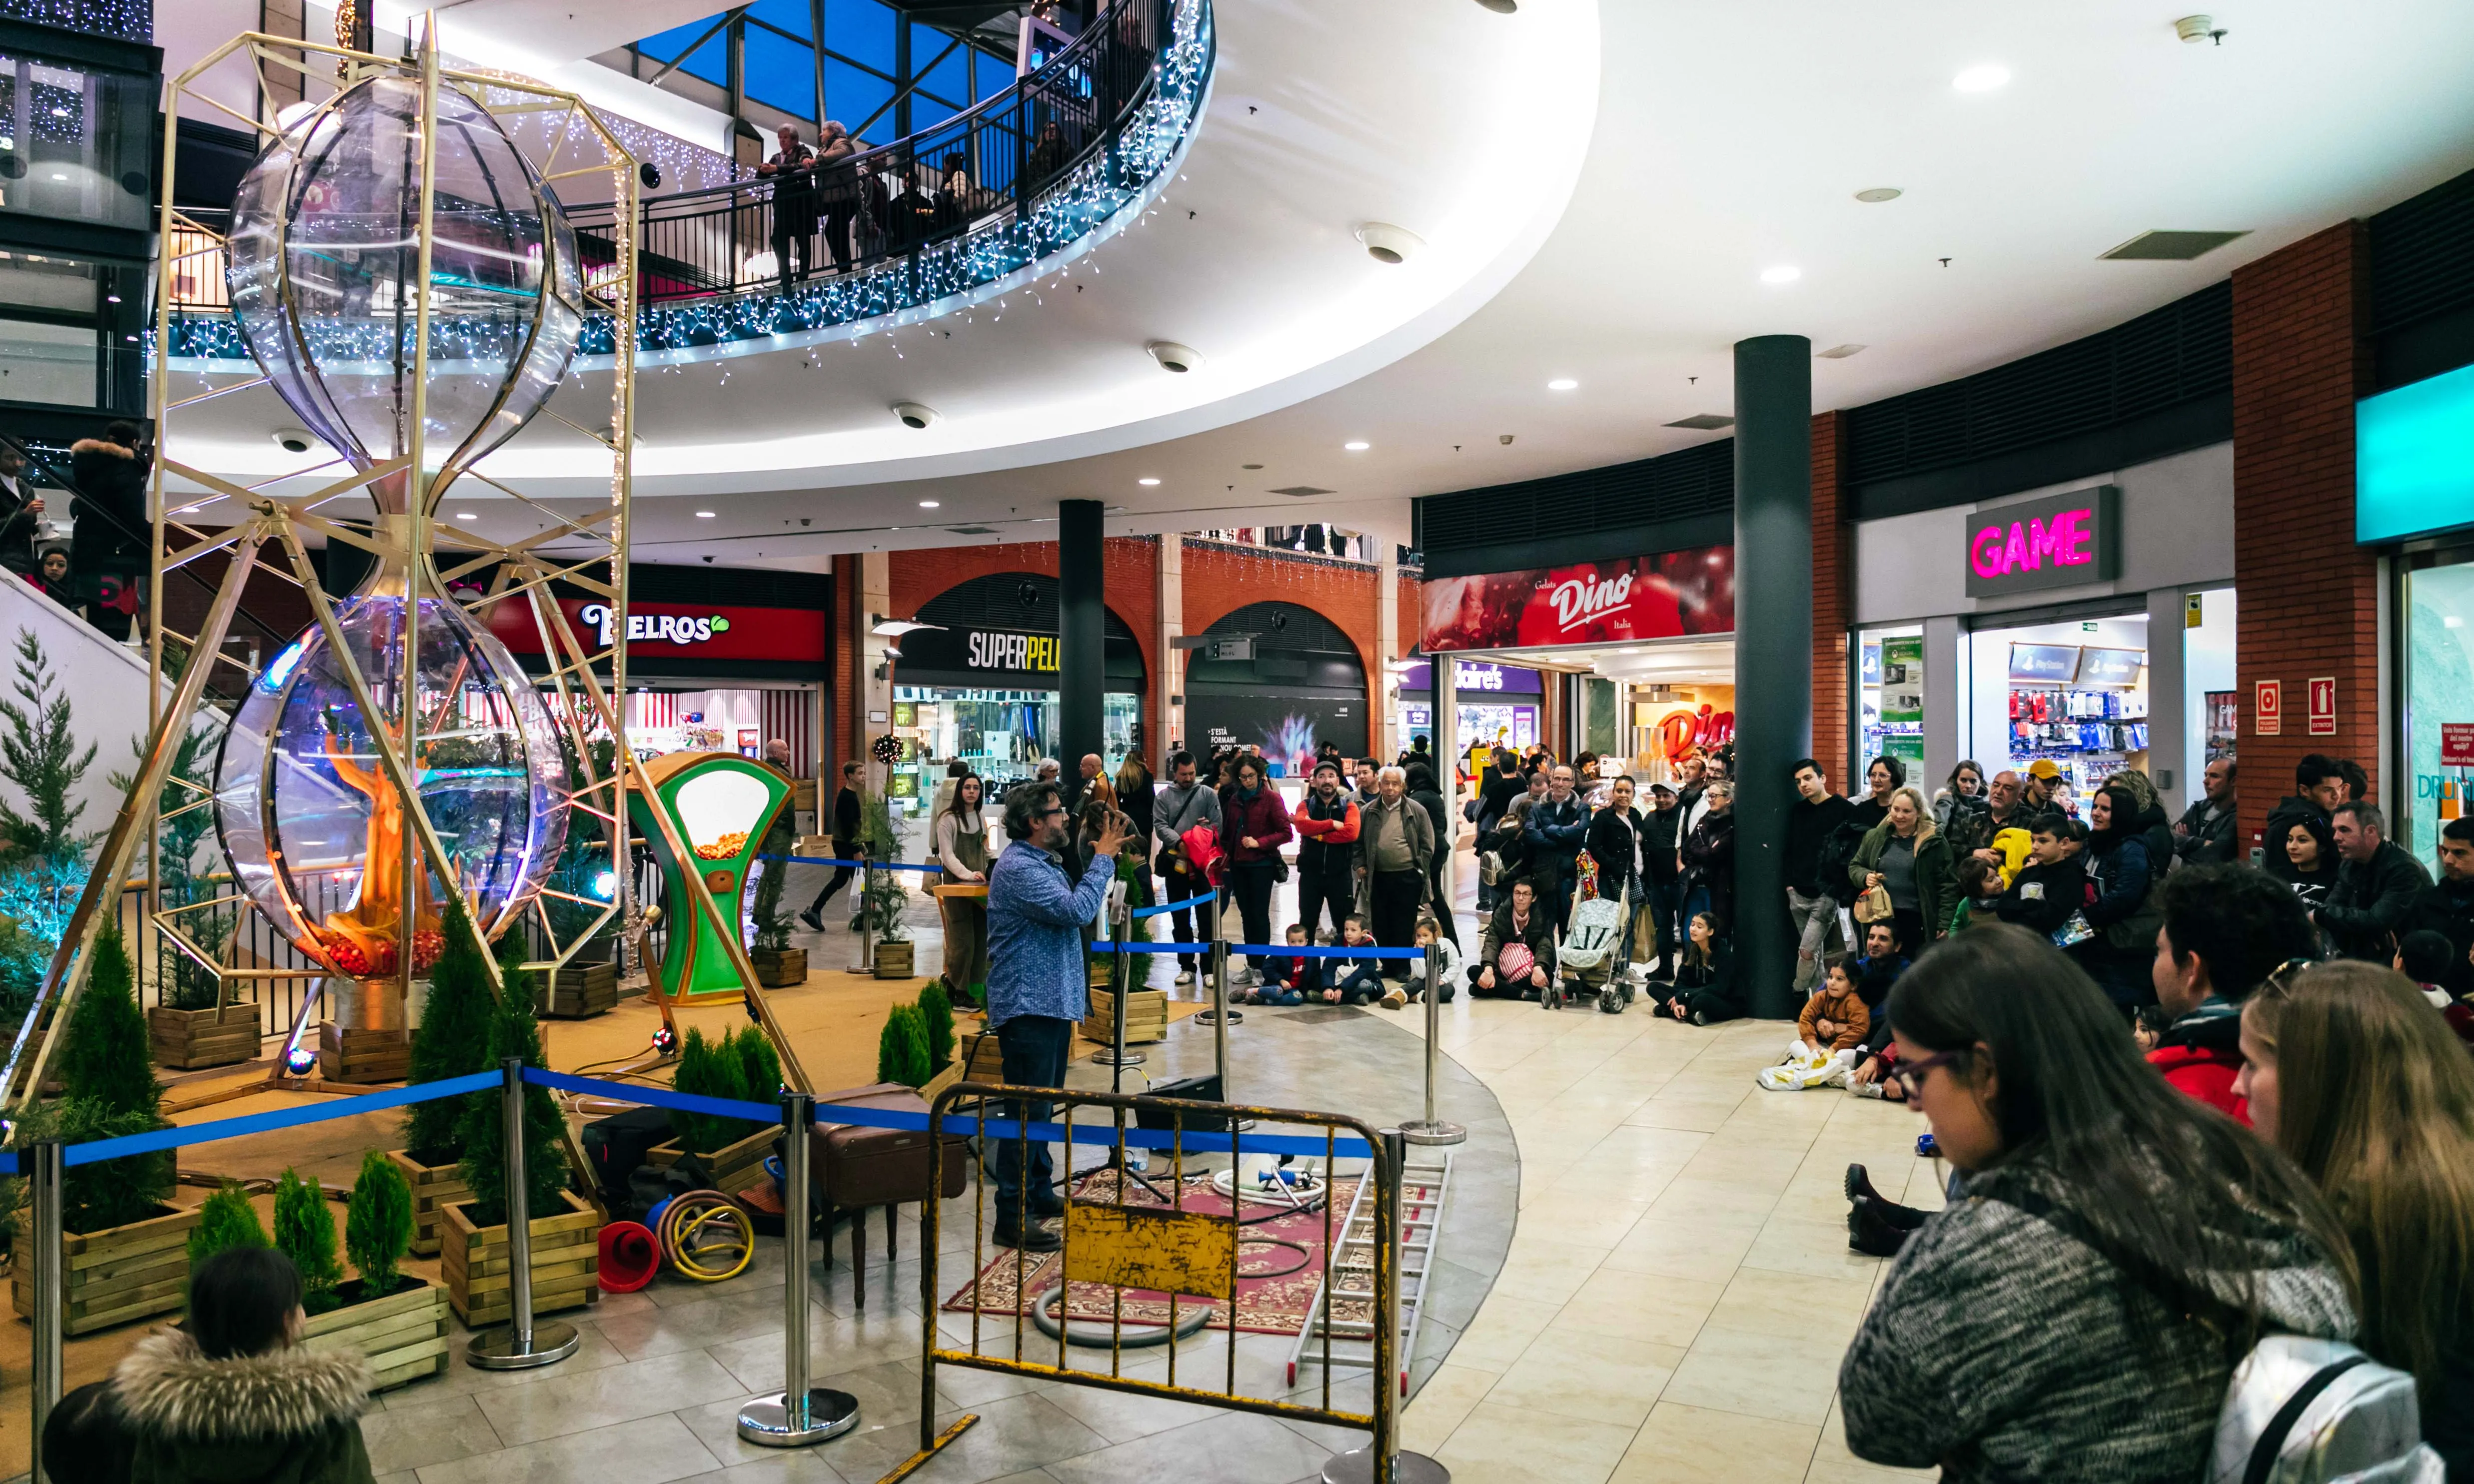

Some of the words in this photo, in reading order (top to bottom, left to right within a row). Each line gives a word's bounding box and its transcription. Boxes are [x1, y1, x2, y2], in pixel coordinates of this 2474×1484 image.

[1971, 508, 2091, 579] GAME
[1535, 579, 1556, 590] Gelats
[1550, 574, 1633, 625] Dino
[1614, 618, 1631, 629] Italia
[1211, 727, 1228, 735] S'ESTÀ
